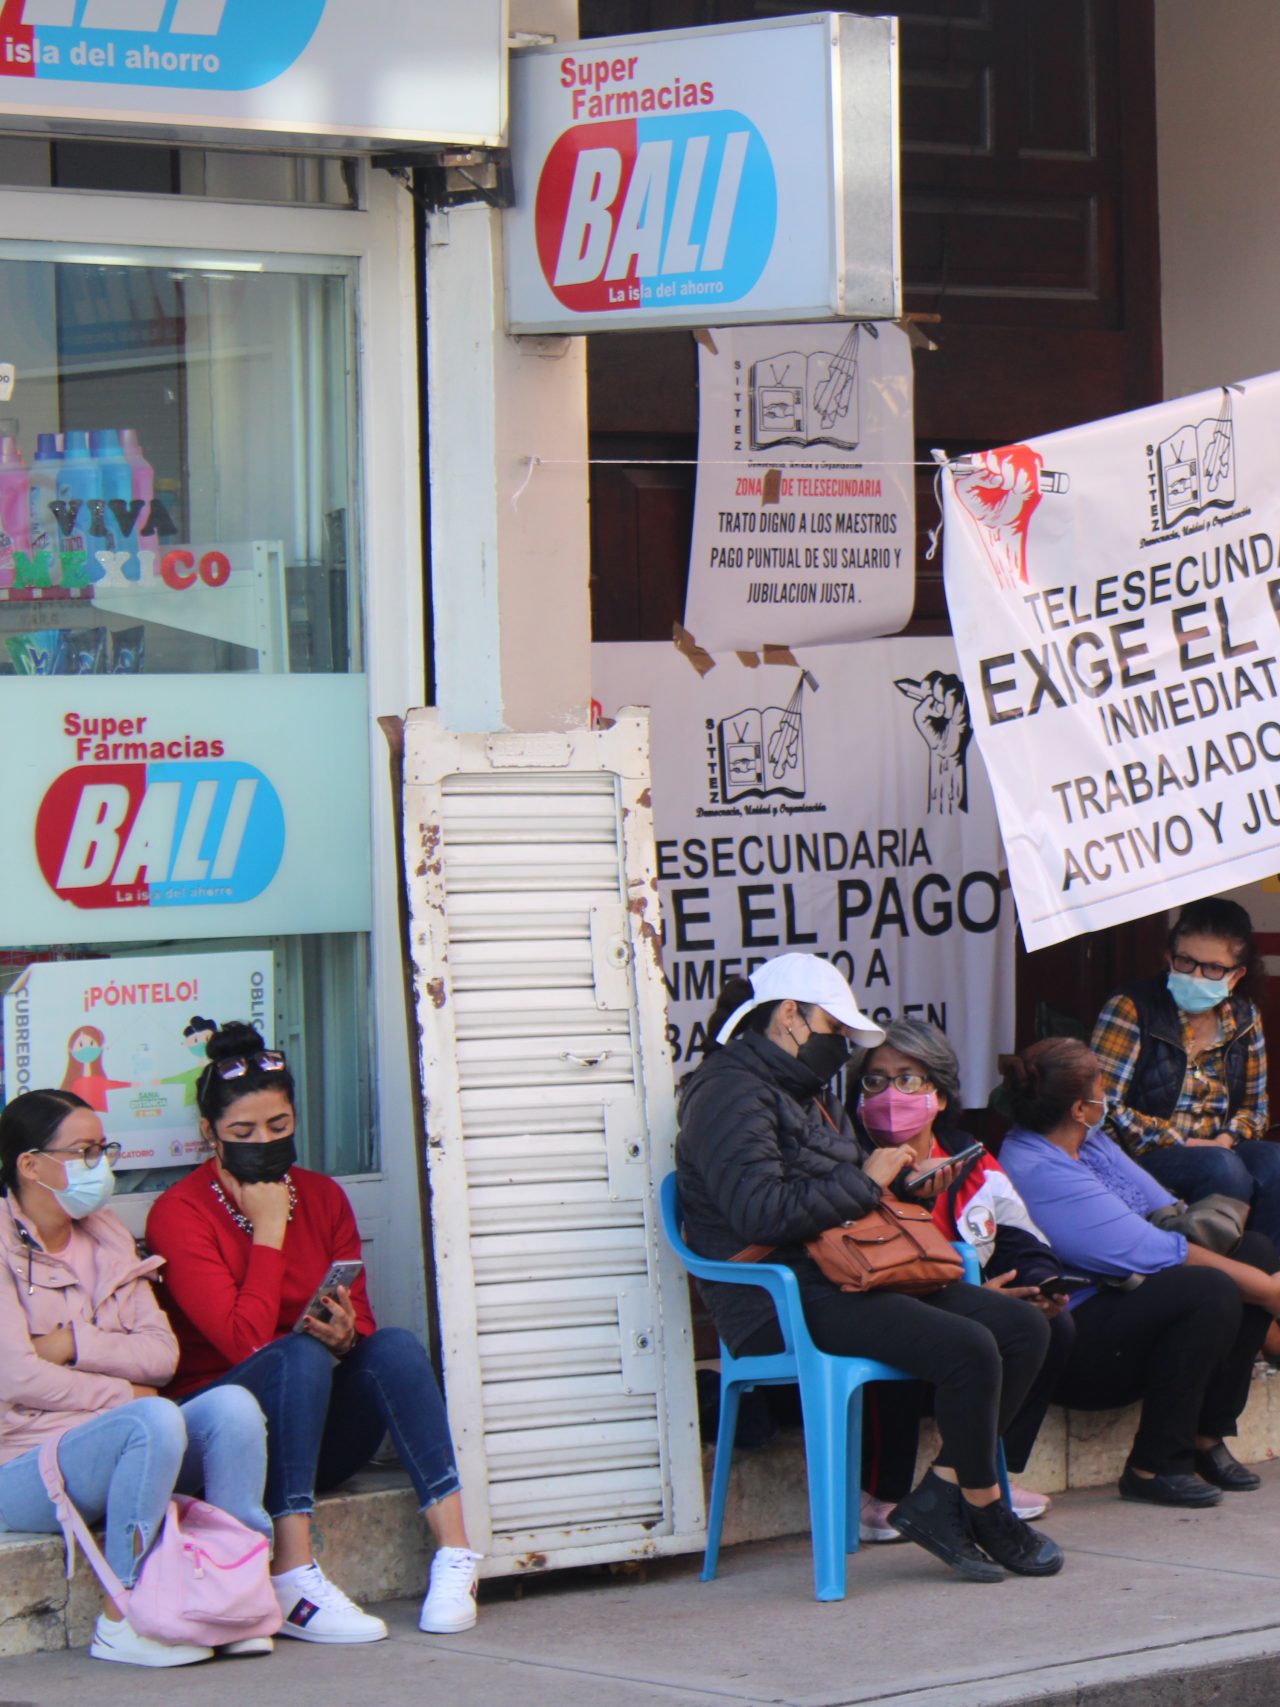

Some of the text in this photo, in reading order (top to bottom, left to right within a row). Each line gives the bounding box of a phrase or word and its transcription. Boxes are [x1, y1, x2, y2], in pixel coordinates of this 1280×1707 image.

[5, 37, 220, 73] isla del ahorro
[560, 56, 638, 90] Super
[571, 78, 714, 120] Farmacias
[553, 131, 750, 287] BALI
[608, 280, 724, 303] La isla del ahorro
[735, 478, 882, 497] ZONA DE TELESECUNDARIA
[48, 498, 178, 538] VIVA
[718, 512, 897, 534] TRATO DIGNO A LOS MAESTROS
[12, 550, 231, 591] MEXICO
[710, 548, 901, 568] PAGO PUNTUAL DE SU SALARIO Y
[747, 583, 815, 603] JUBILACION
[979, 618, 1160, 726] EXIGE
[1172, 597, 1257, 671] EL
[64, 712, 147, 740] Super
[76, 735, 225, 761] Farmacias
[55, 778, 259, 889] BALI
[1061, 815, 1193, 892] ACTIVO
[1199, 802, 1224, 845] Y
[116, 889, 132, 902] La
[738, 883, 819, 948] EL
[838, 872, 1000, 941] PAGO
[865, 948, 890, 988] A
[83, 979, 199, 1012] ¡PÓNTELO!
